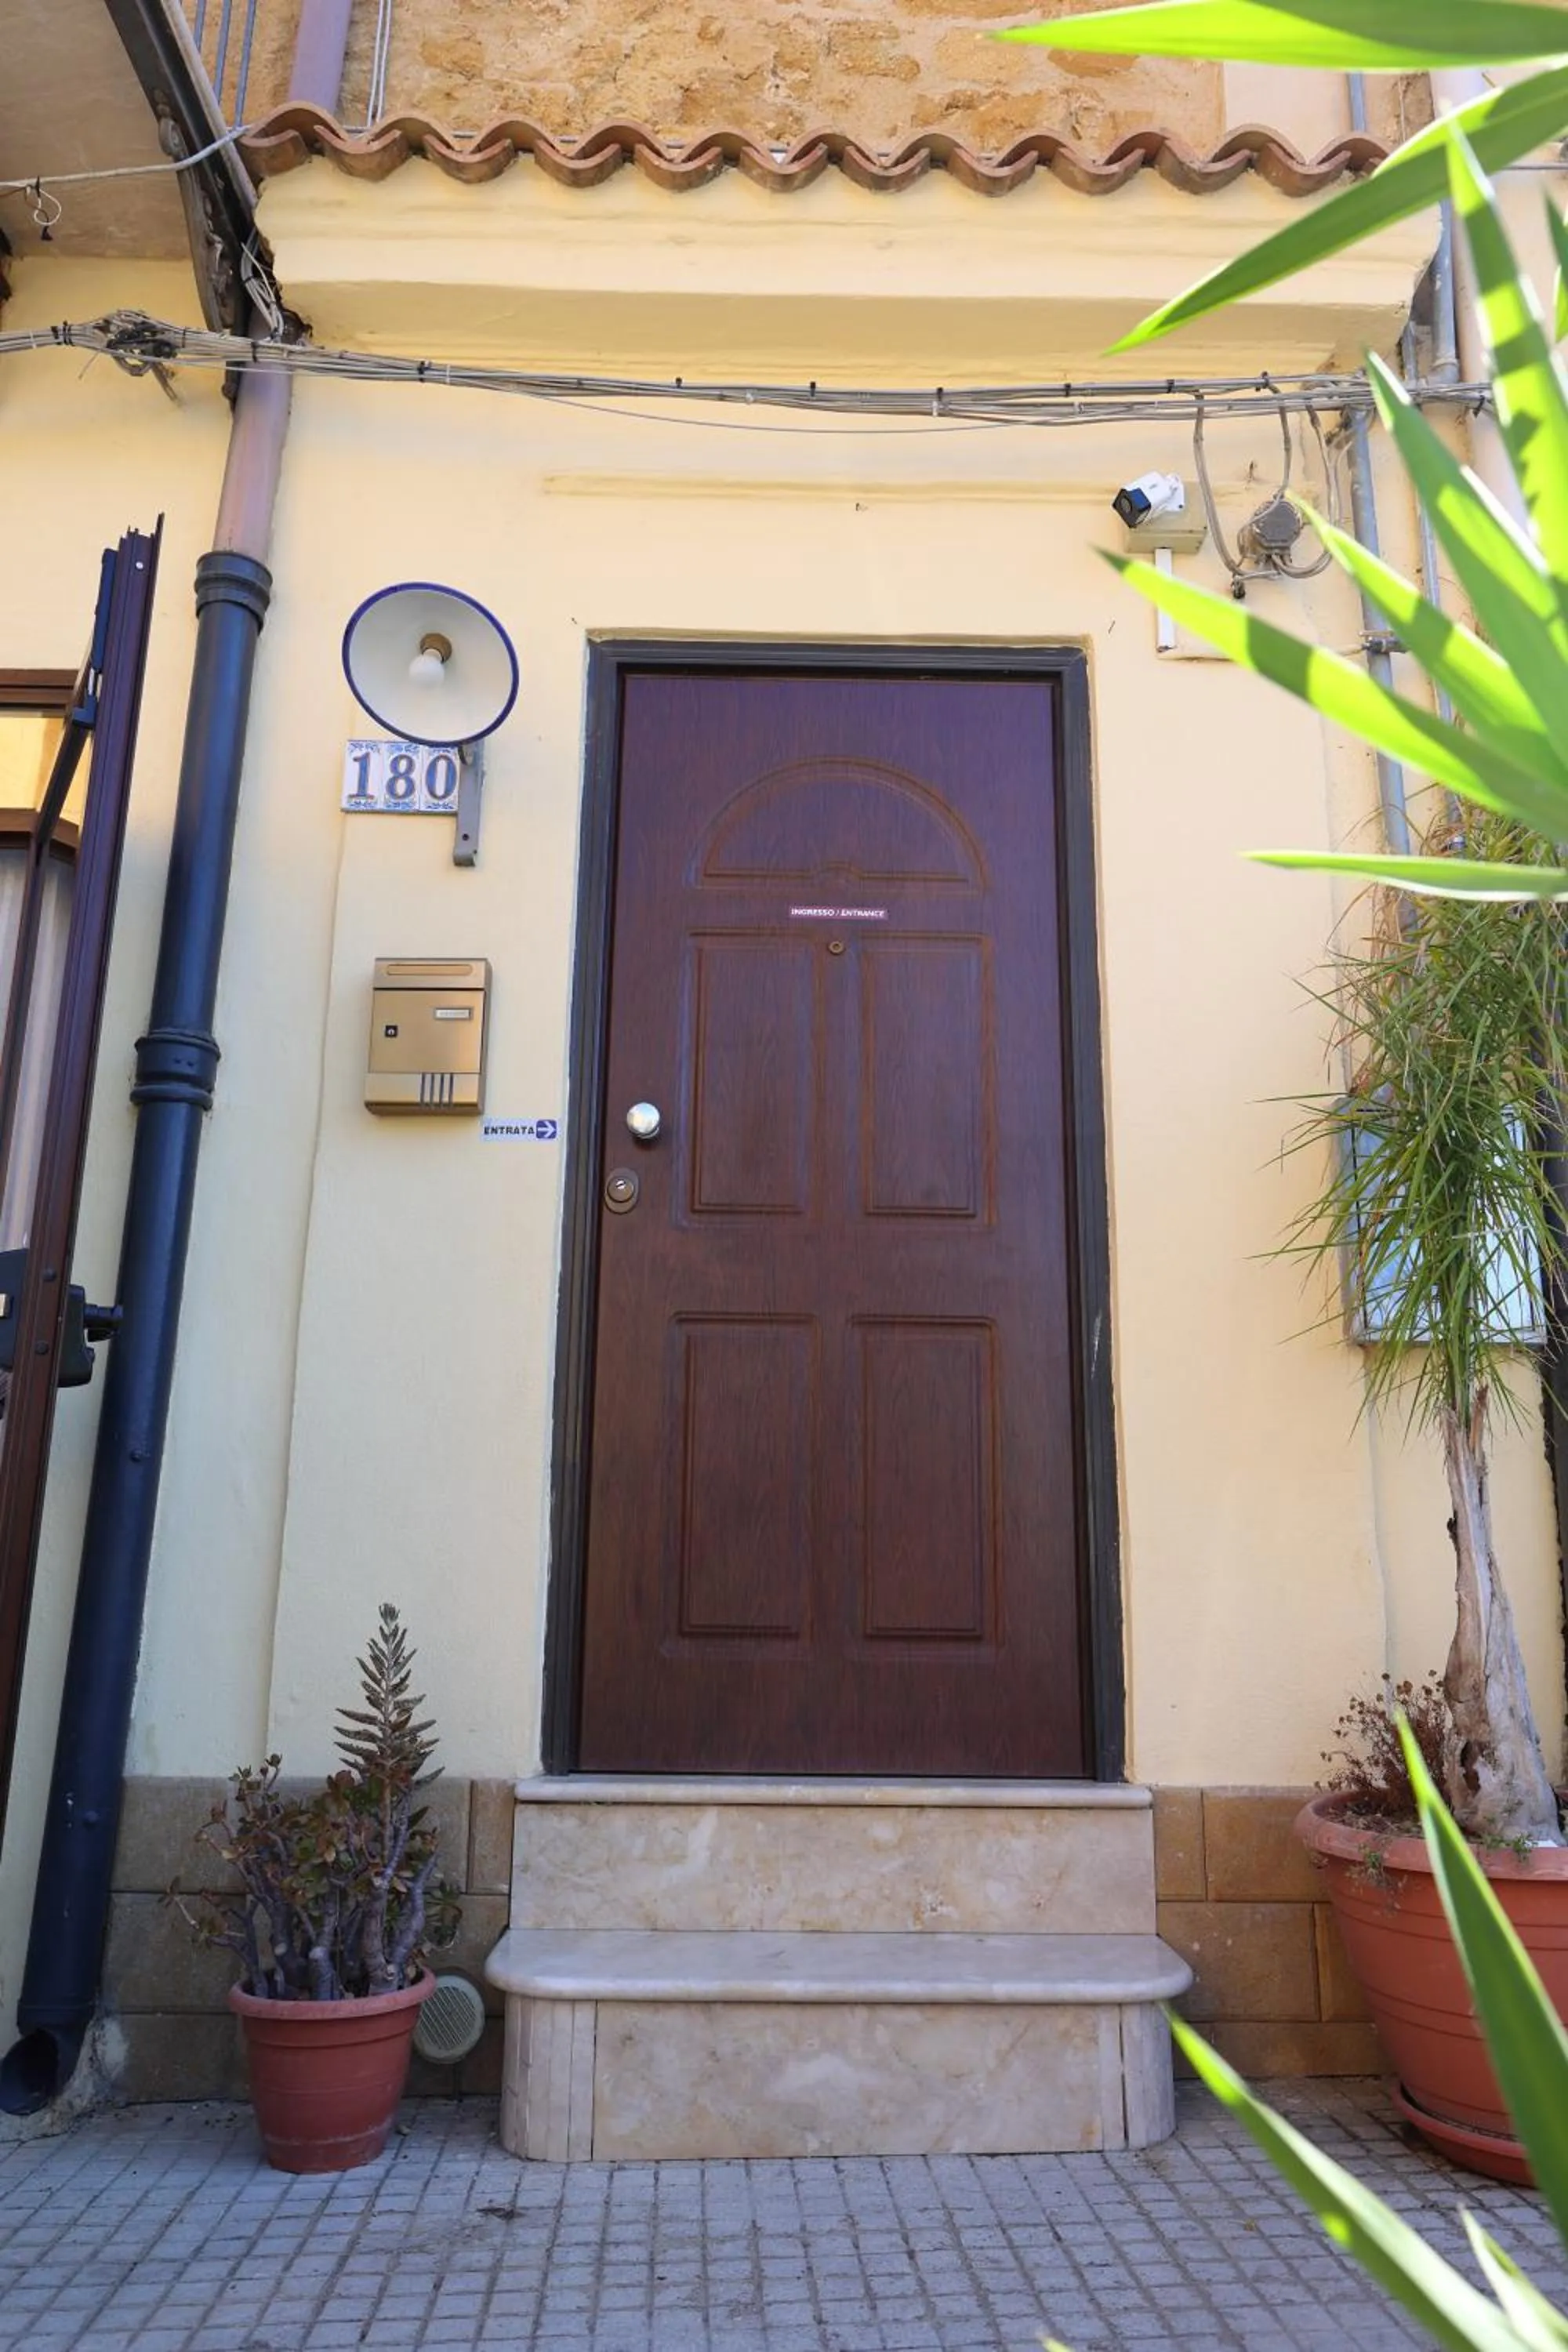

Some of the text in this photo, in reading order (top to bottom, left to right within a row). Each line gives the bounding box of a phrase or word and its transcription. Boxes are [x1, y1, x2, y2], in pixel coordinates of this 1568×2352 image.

[347, 752, 457, 800] 180
[791, 908, 835, 916] INGRESSO
[840, 909, 884, 917] ENTRANCE
[484, 1125, 535, 1135] ENTRATA
